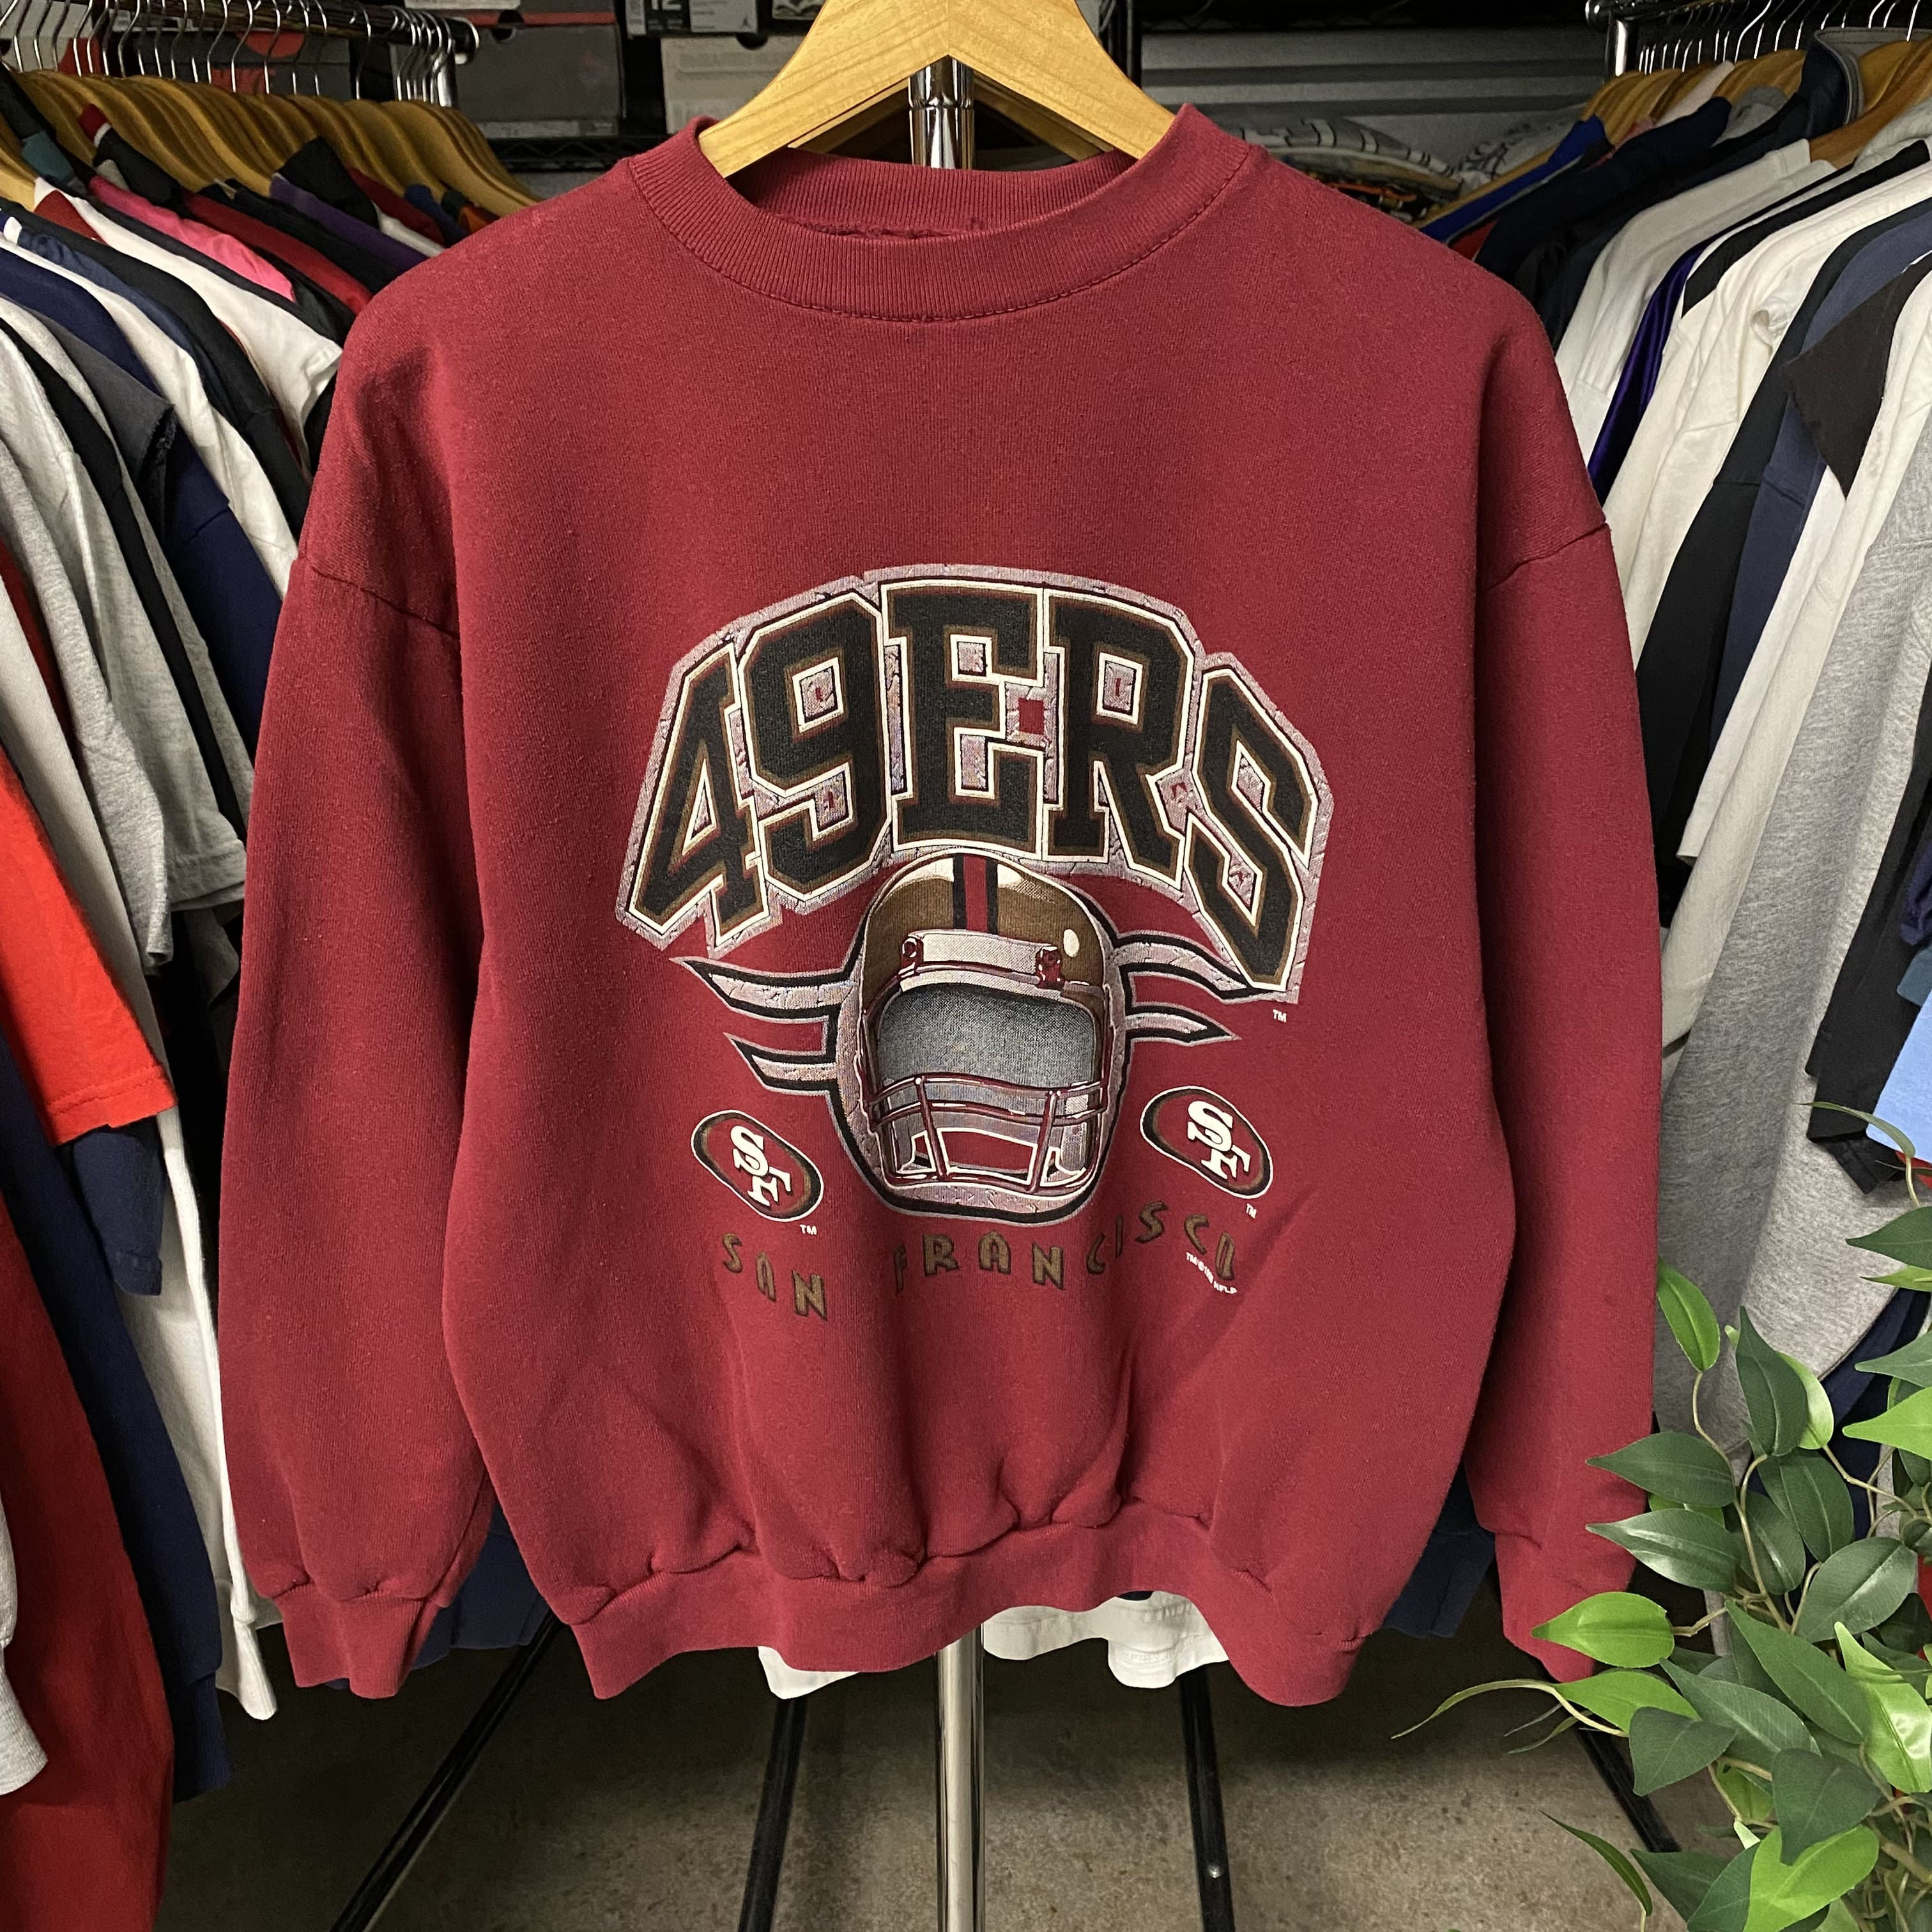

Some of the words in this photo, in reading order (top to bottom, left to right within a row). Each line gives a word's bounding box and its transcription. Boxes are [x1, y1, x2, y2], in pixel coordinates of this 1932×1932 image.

[625, 575, 1322, 993] 49ERS
[1273, 1009, 1287, 1022] TM
[730, 1125, 792, 1206] SF
[1186, 1100, 1250, 1179] SF
[799, 1224, 817, 1235] TM
[1246, 1203, 1257, 1218] TM
[722, 1232, 827, 1321] SAN
[893, 1200, 1235, 1295] FRANCISCO
